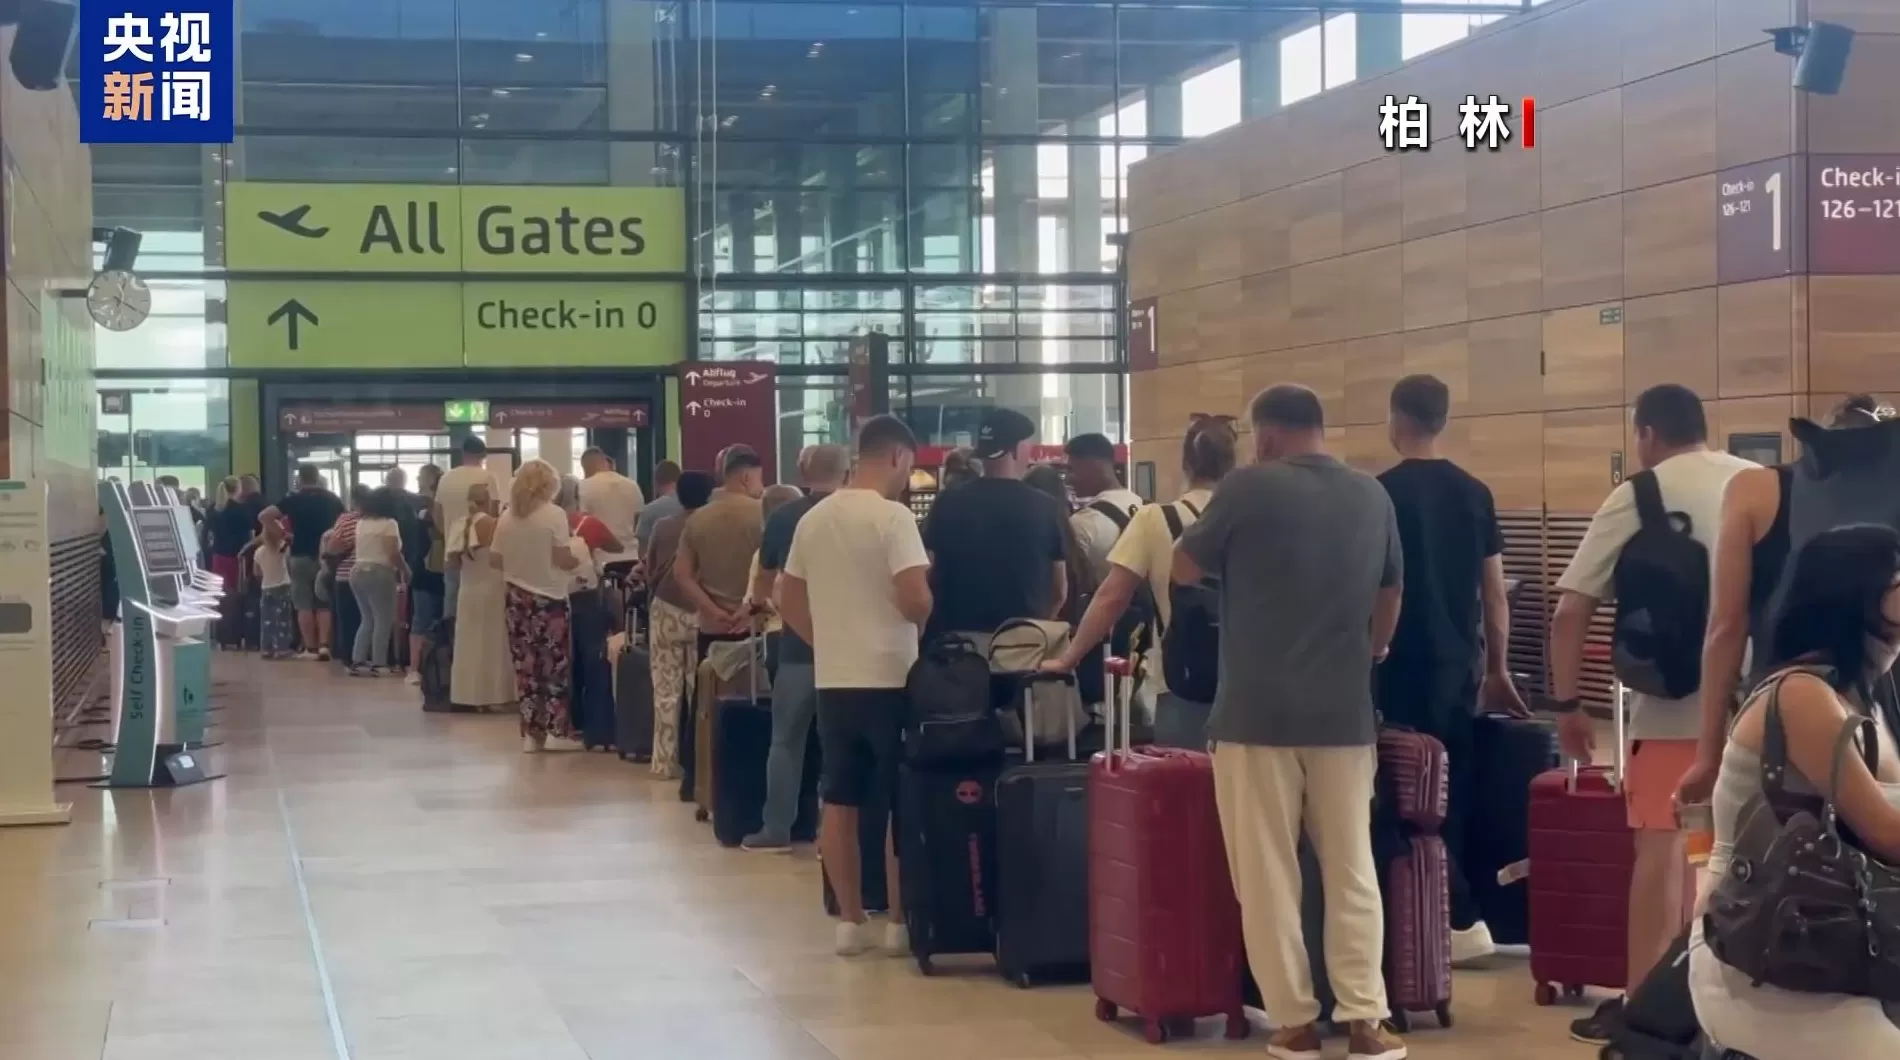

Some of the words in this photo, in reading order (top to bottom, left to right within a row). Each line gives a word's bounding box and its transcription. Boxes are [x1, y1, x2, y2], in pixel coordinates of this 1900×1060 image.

[359, 200, 446, 254] All
[477, 204, 645, 255] Gates
[1765, 172, 1781, 251] 1
[477, 299, 625, 329] Check-in
[703, 398, 746, 407] Check-in
[130, 616, 144, 684] Check-in
[129, 689, 144, 719] Self
